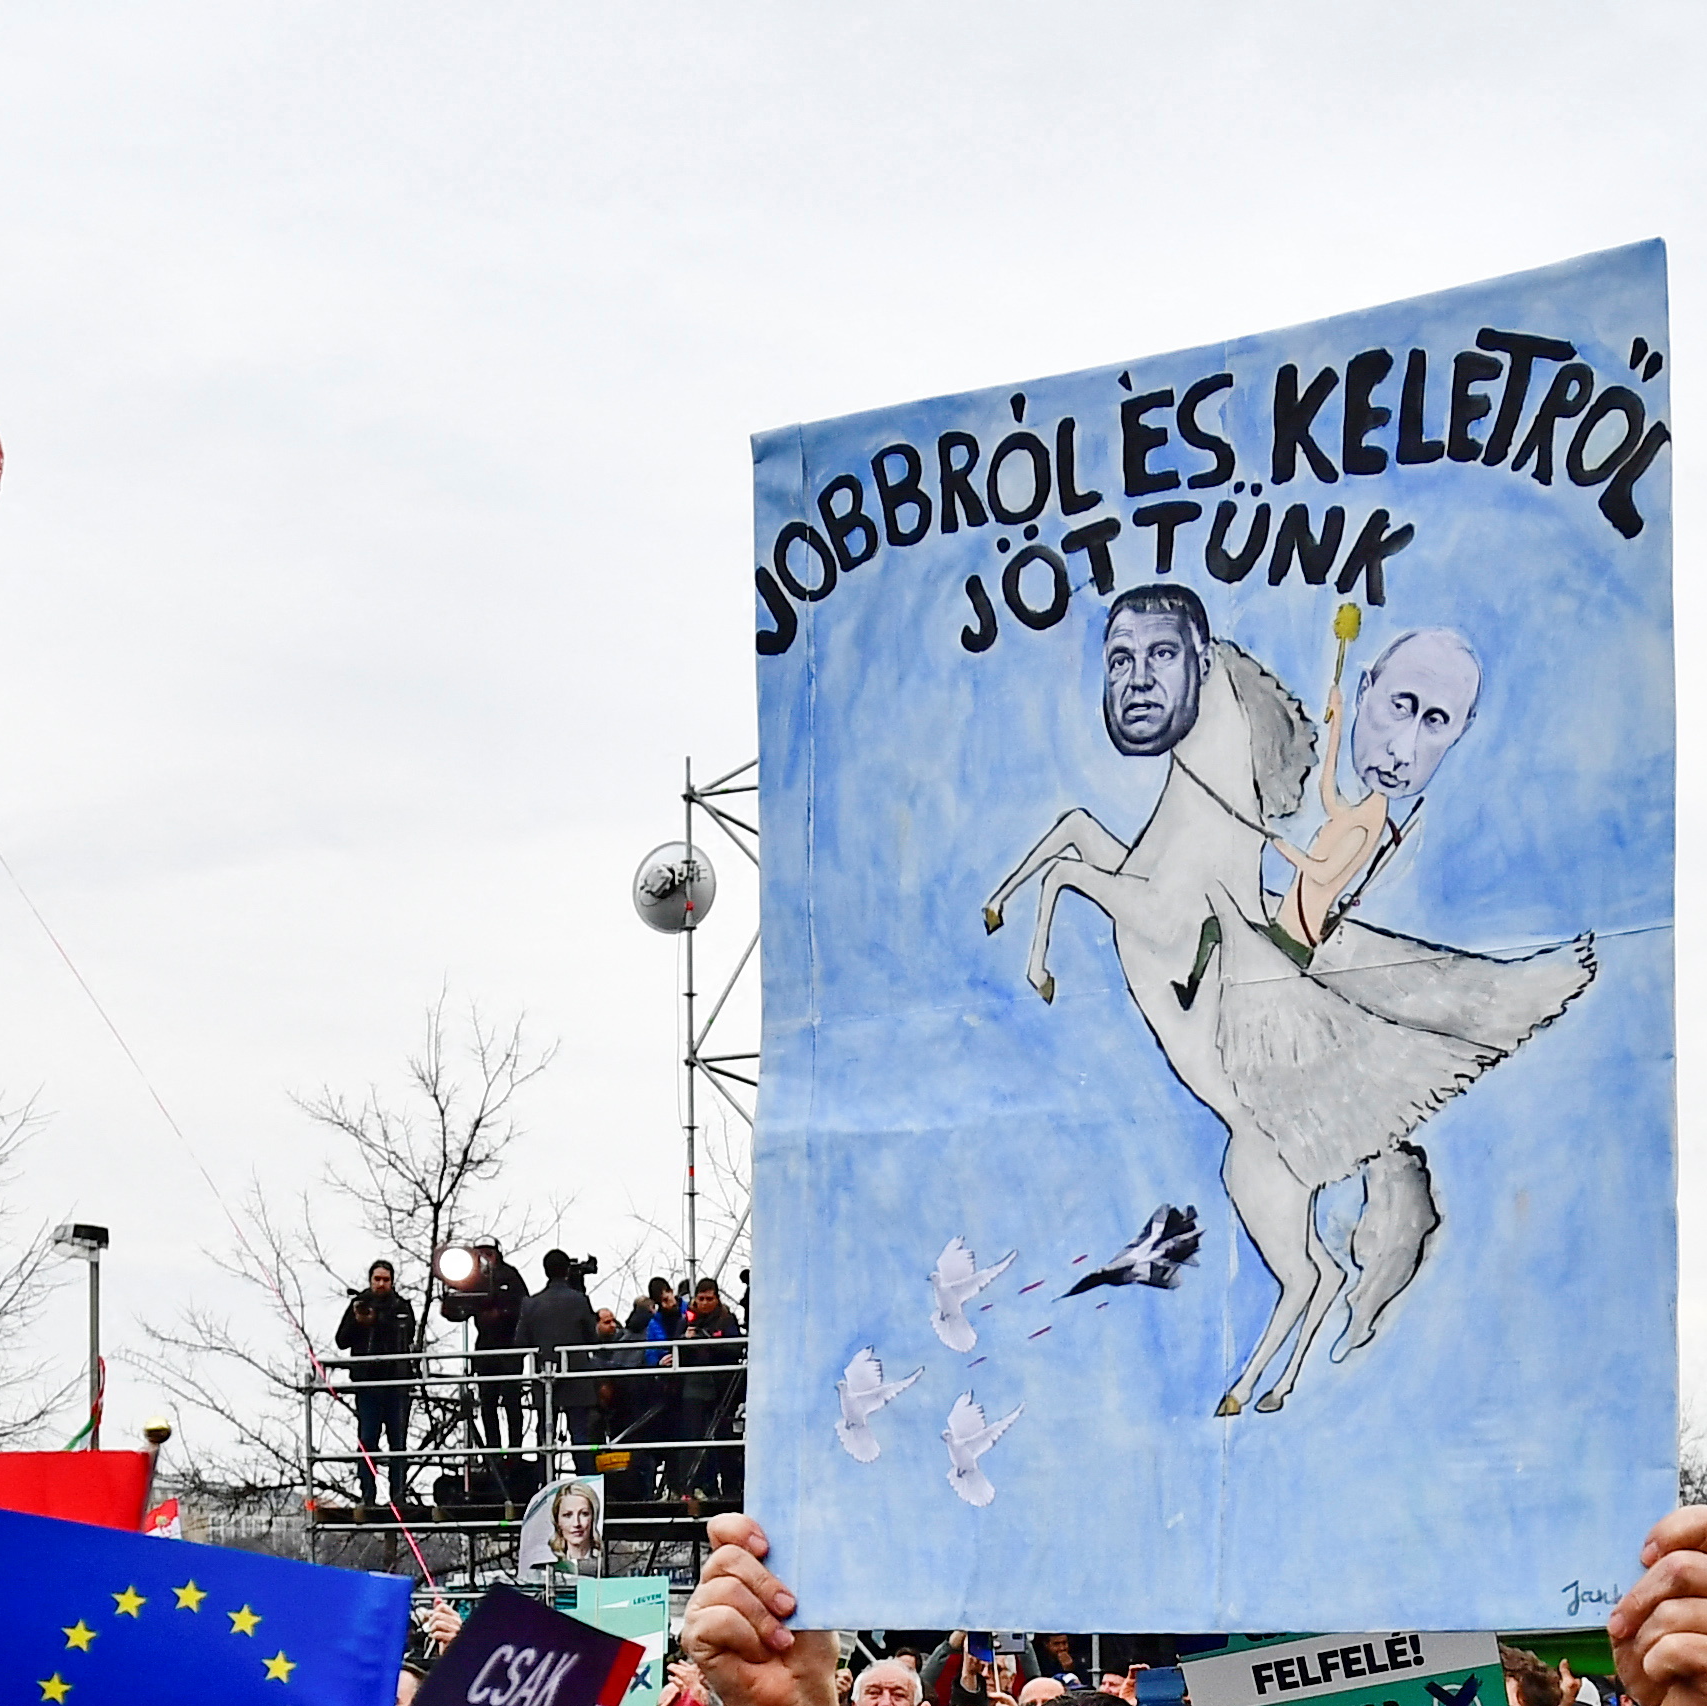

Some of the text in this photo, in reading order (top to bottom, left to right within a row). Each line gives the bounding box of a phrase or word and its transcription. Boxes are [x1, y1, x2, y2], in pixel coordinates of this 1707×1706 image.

[755, 392, 1102, 655] JOBBRÓL
[1271, 328, 1671, 539] KELETRŐL
[961, 481, 1415, 653] JÖTTÜNK
[1251, 1632, 1425, 1696] FELFELÉ!
